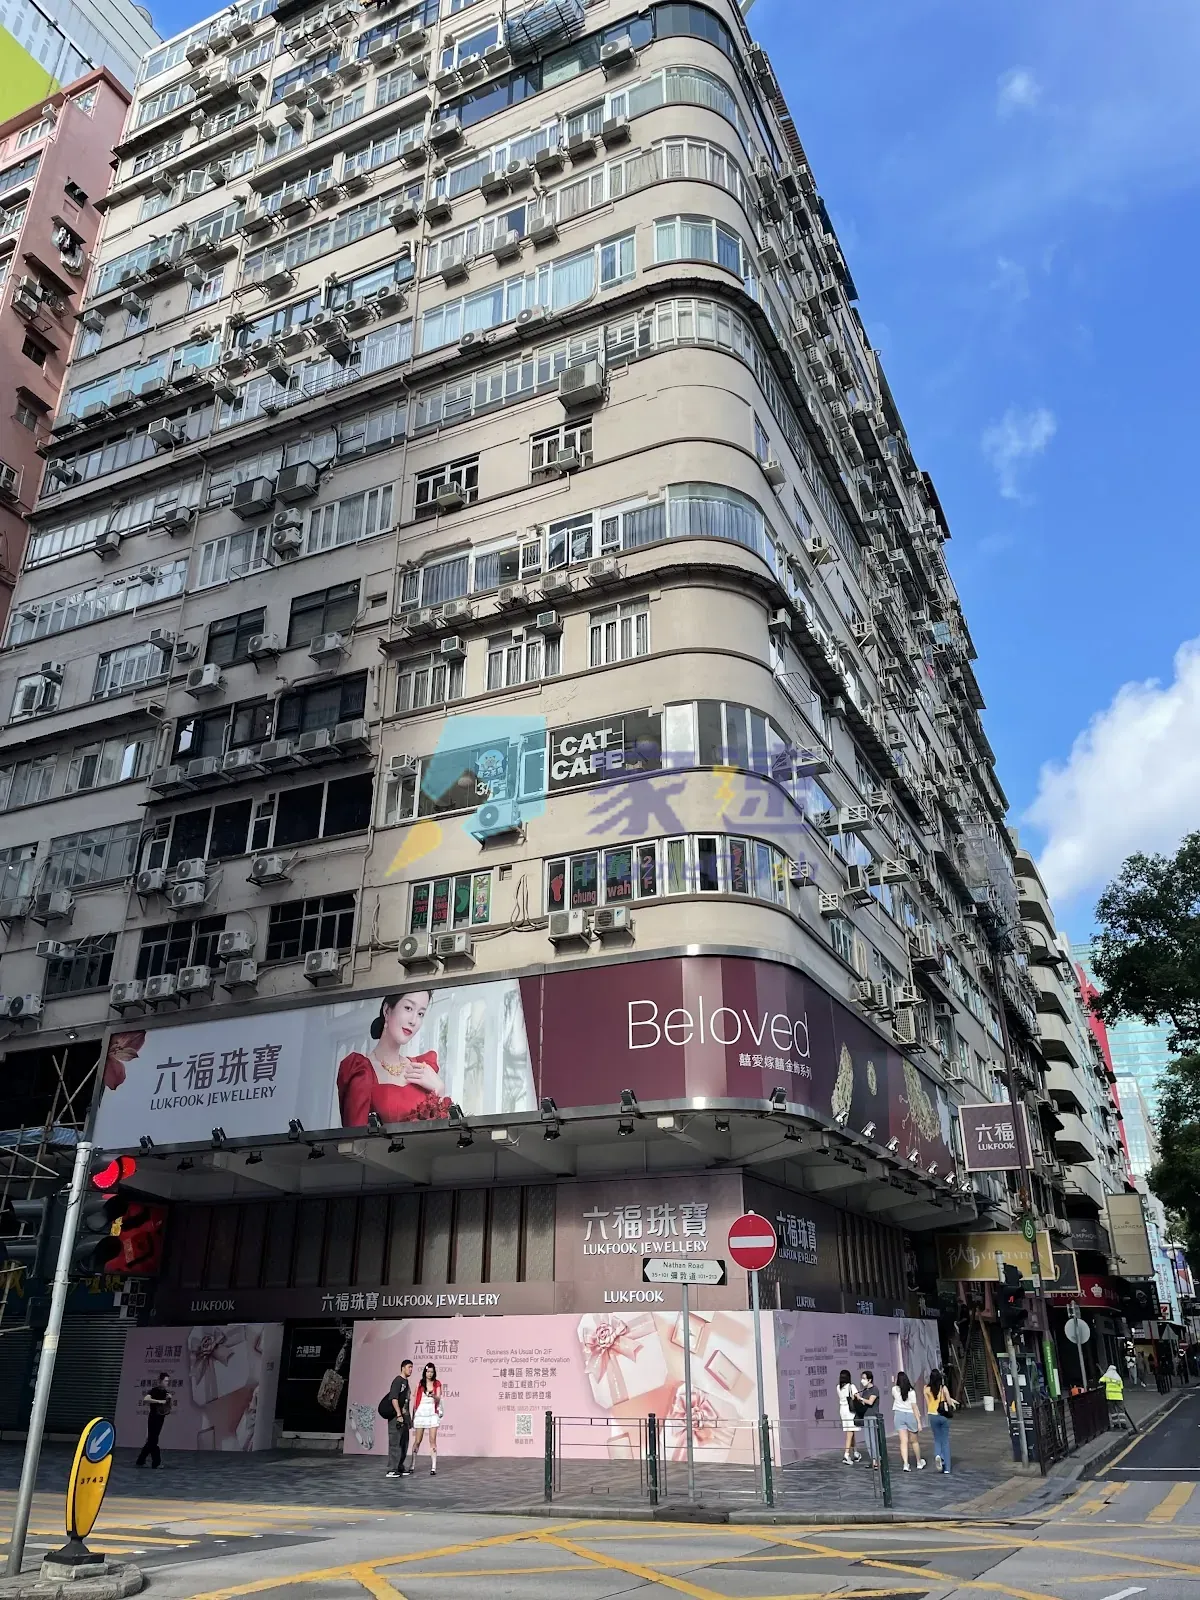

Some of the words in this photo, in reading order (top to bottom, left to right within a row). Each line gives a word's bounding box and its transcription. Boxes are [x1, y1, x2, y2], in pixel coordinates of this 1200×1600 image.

[560, 728, 613, 757] CAT
[551, 749, 623, 781] CAFE
[574, 860, 596, 886] 中
[608, 853, 631, 879] 華
[573, 889, 597, 904] chung
[607, 880, 631, 897] wah
[628, 996, 811, 1058] Beloved
[153, 1044, 283, 1095] 六福珠寶
[150, 1094, 204, 1111] LUKFOOK
[206, 1085, 277, 1107] JEWELLERY
[975, 1123, 1014, 1142] 六福
[978, 1142, 1015, 1151] LUKFOOK
[583, 1202, 709, 1241] 六福珠寶
[776, 1211, 817, 1252] 六福珠寶
[584, 1242, 638, 1256] LUKFOOK
[640, 1240, 709, 1256] JEWELLERY
[663, 1261, 687, 1269] Nathan
[670, 1271, 696, 1280] 彌敦道
[191, 1299, 235, 1311] LUKFOOK
[322, 1292, 380, 1312] 六福珠寶
[382, 1295, 433, 1307] LUKFOOK
[436, 1293, 501, 1308] JEWELLERY
[604, 1290, 665, 1303] LUKFOOK
[414, 1339, 460, 1354] 六福珠寶
[486, 1348, 509, 1356] Business
[480, 1356, 510, 1365] Temporarily
[525, 1367, 557, 1377] 照常營業
[80, 1476, 104, 1485] 3743
